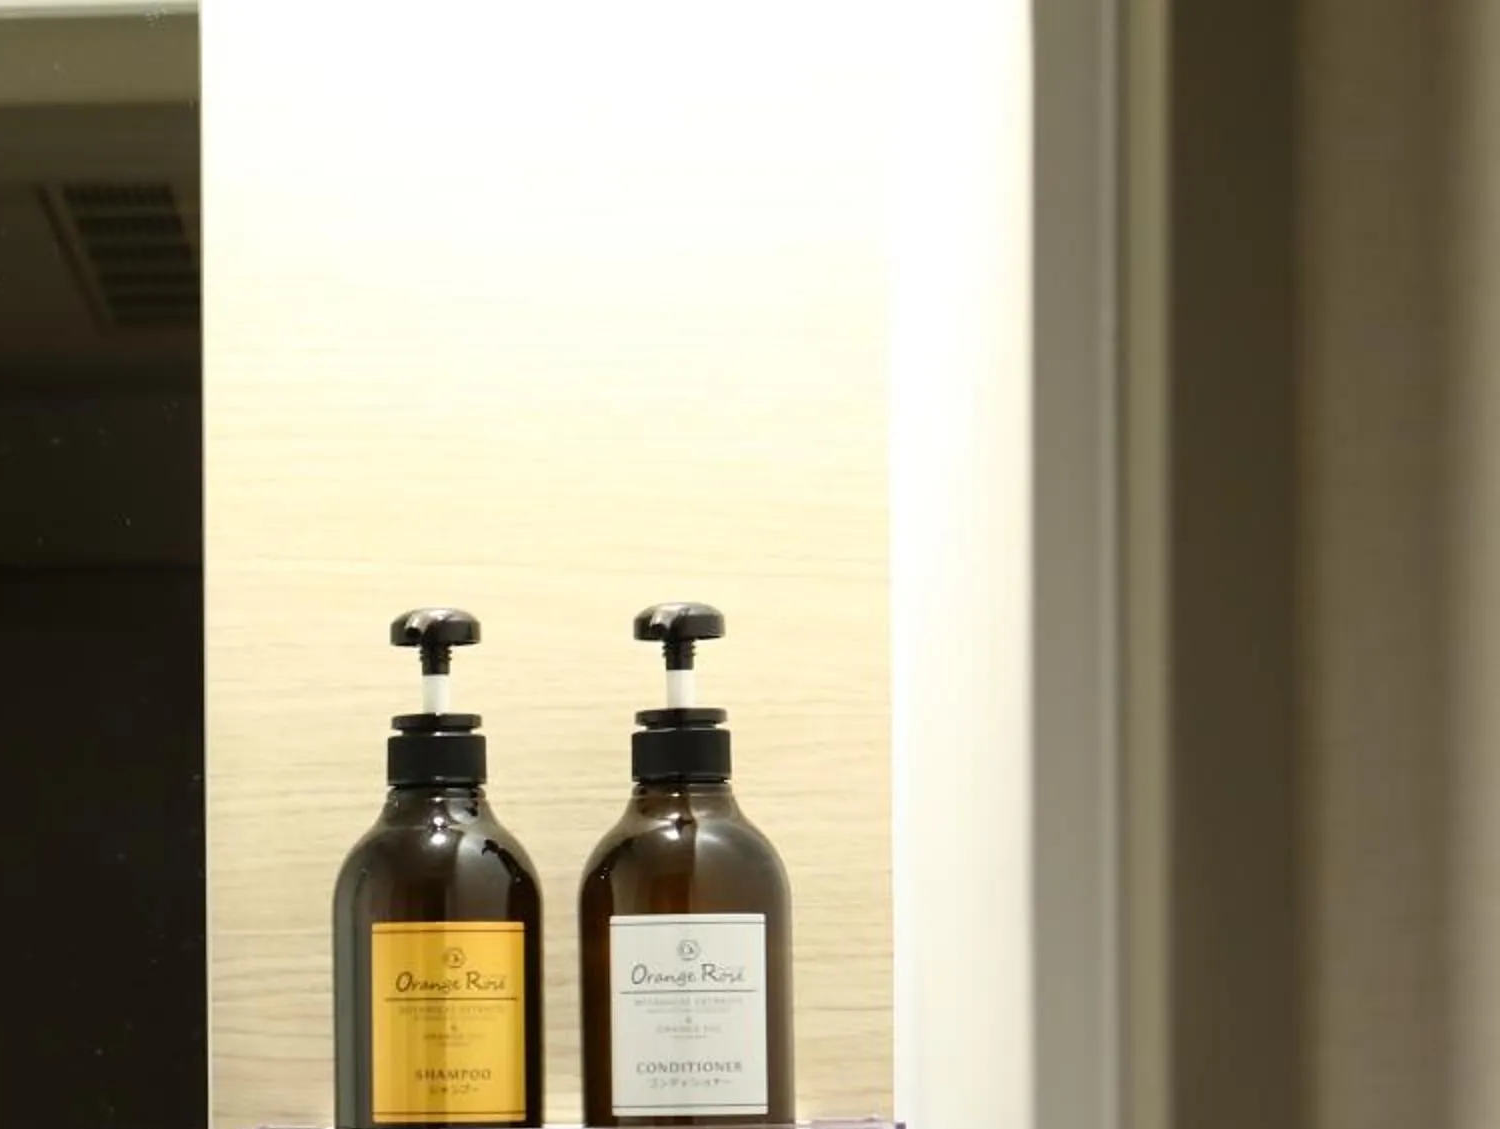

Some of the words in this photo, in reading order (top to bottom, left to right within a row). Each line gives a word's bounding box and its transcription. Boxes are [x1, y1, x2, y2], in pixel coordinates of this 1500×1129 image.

[395, 971, 462, 994] Orange
[631, 963, 696, 986] Orange
[415, 1068, 492, 1081] SHAMPOO
[636, 1061, 743, 1074] CONDITIONER
